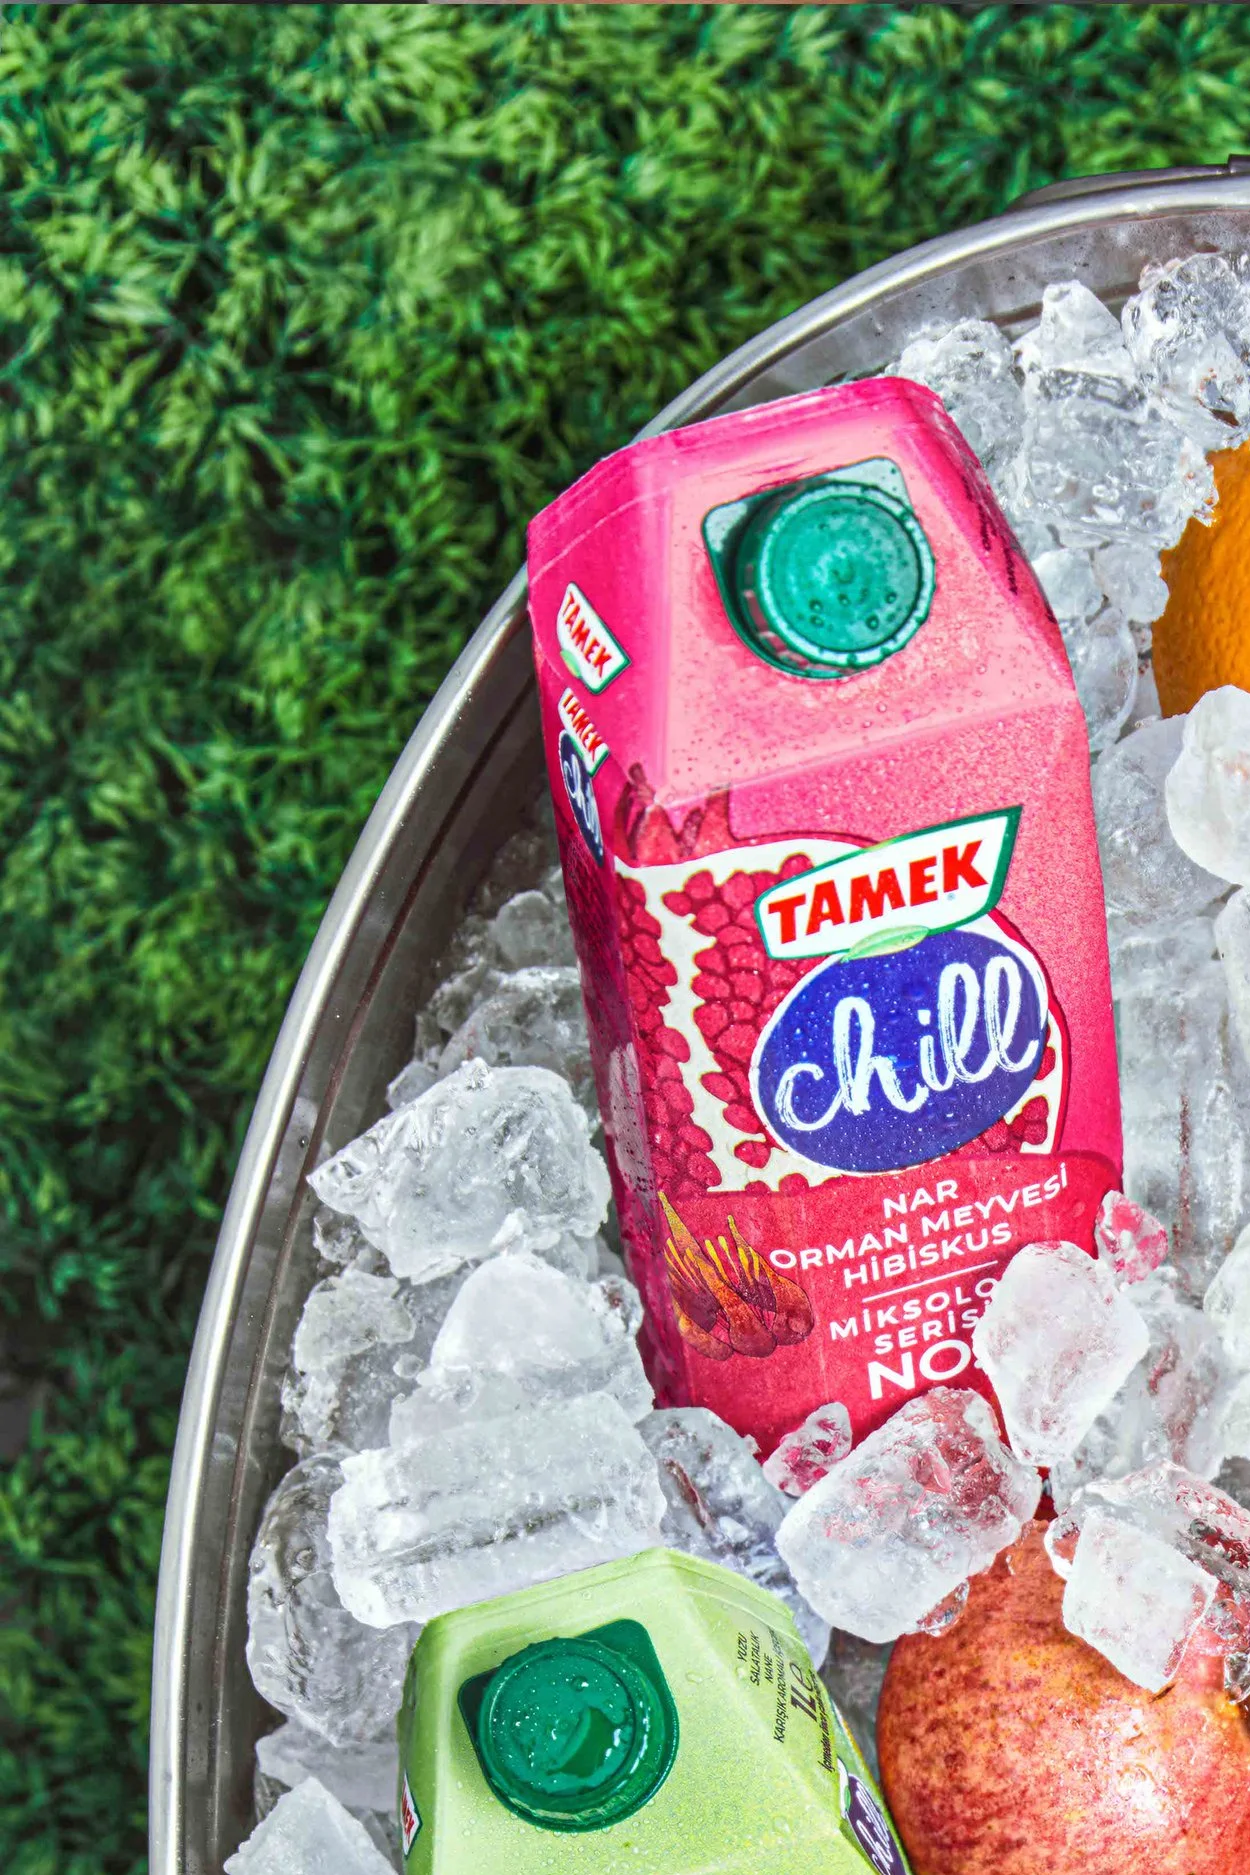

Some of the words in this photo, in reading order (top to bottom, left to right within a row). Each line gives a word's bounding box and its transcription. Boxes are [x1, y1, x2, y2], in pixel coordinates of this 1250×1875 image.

[562, 591, 612, 678] TAMEK
[562, 693, 603, 762] TAMEK
[768, 840, 989, 943] TAMEK
[776, 955, 1040, 1131] chill
[769, 1220, 916, 1271] ORMAN
[921, 1164, 1068, 1239] MEYVESİ
[882, 1180, 958, 1219] NAR
[843, 1222, 1012, 1288] HİBİSKUS
[829, 1277, 999, 1340] MİKSOLO
[874, 1302, 982, 1355] SERİS
[868, 1339, 984, 1400] NO.
[737, 1632, 748, 1662] YUZU
[750, 1630, 760, 1686] SALATALIK
[764, 1653, 774, 1684] NANE
[775, 1657, 786, 1699] AROMALI
[773, 1698, 788, 1743] KARIŞIK
